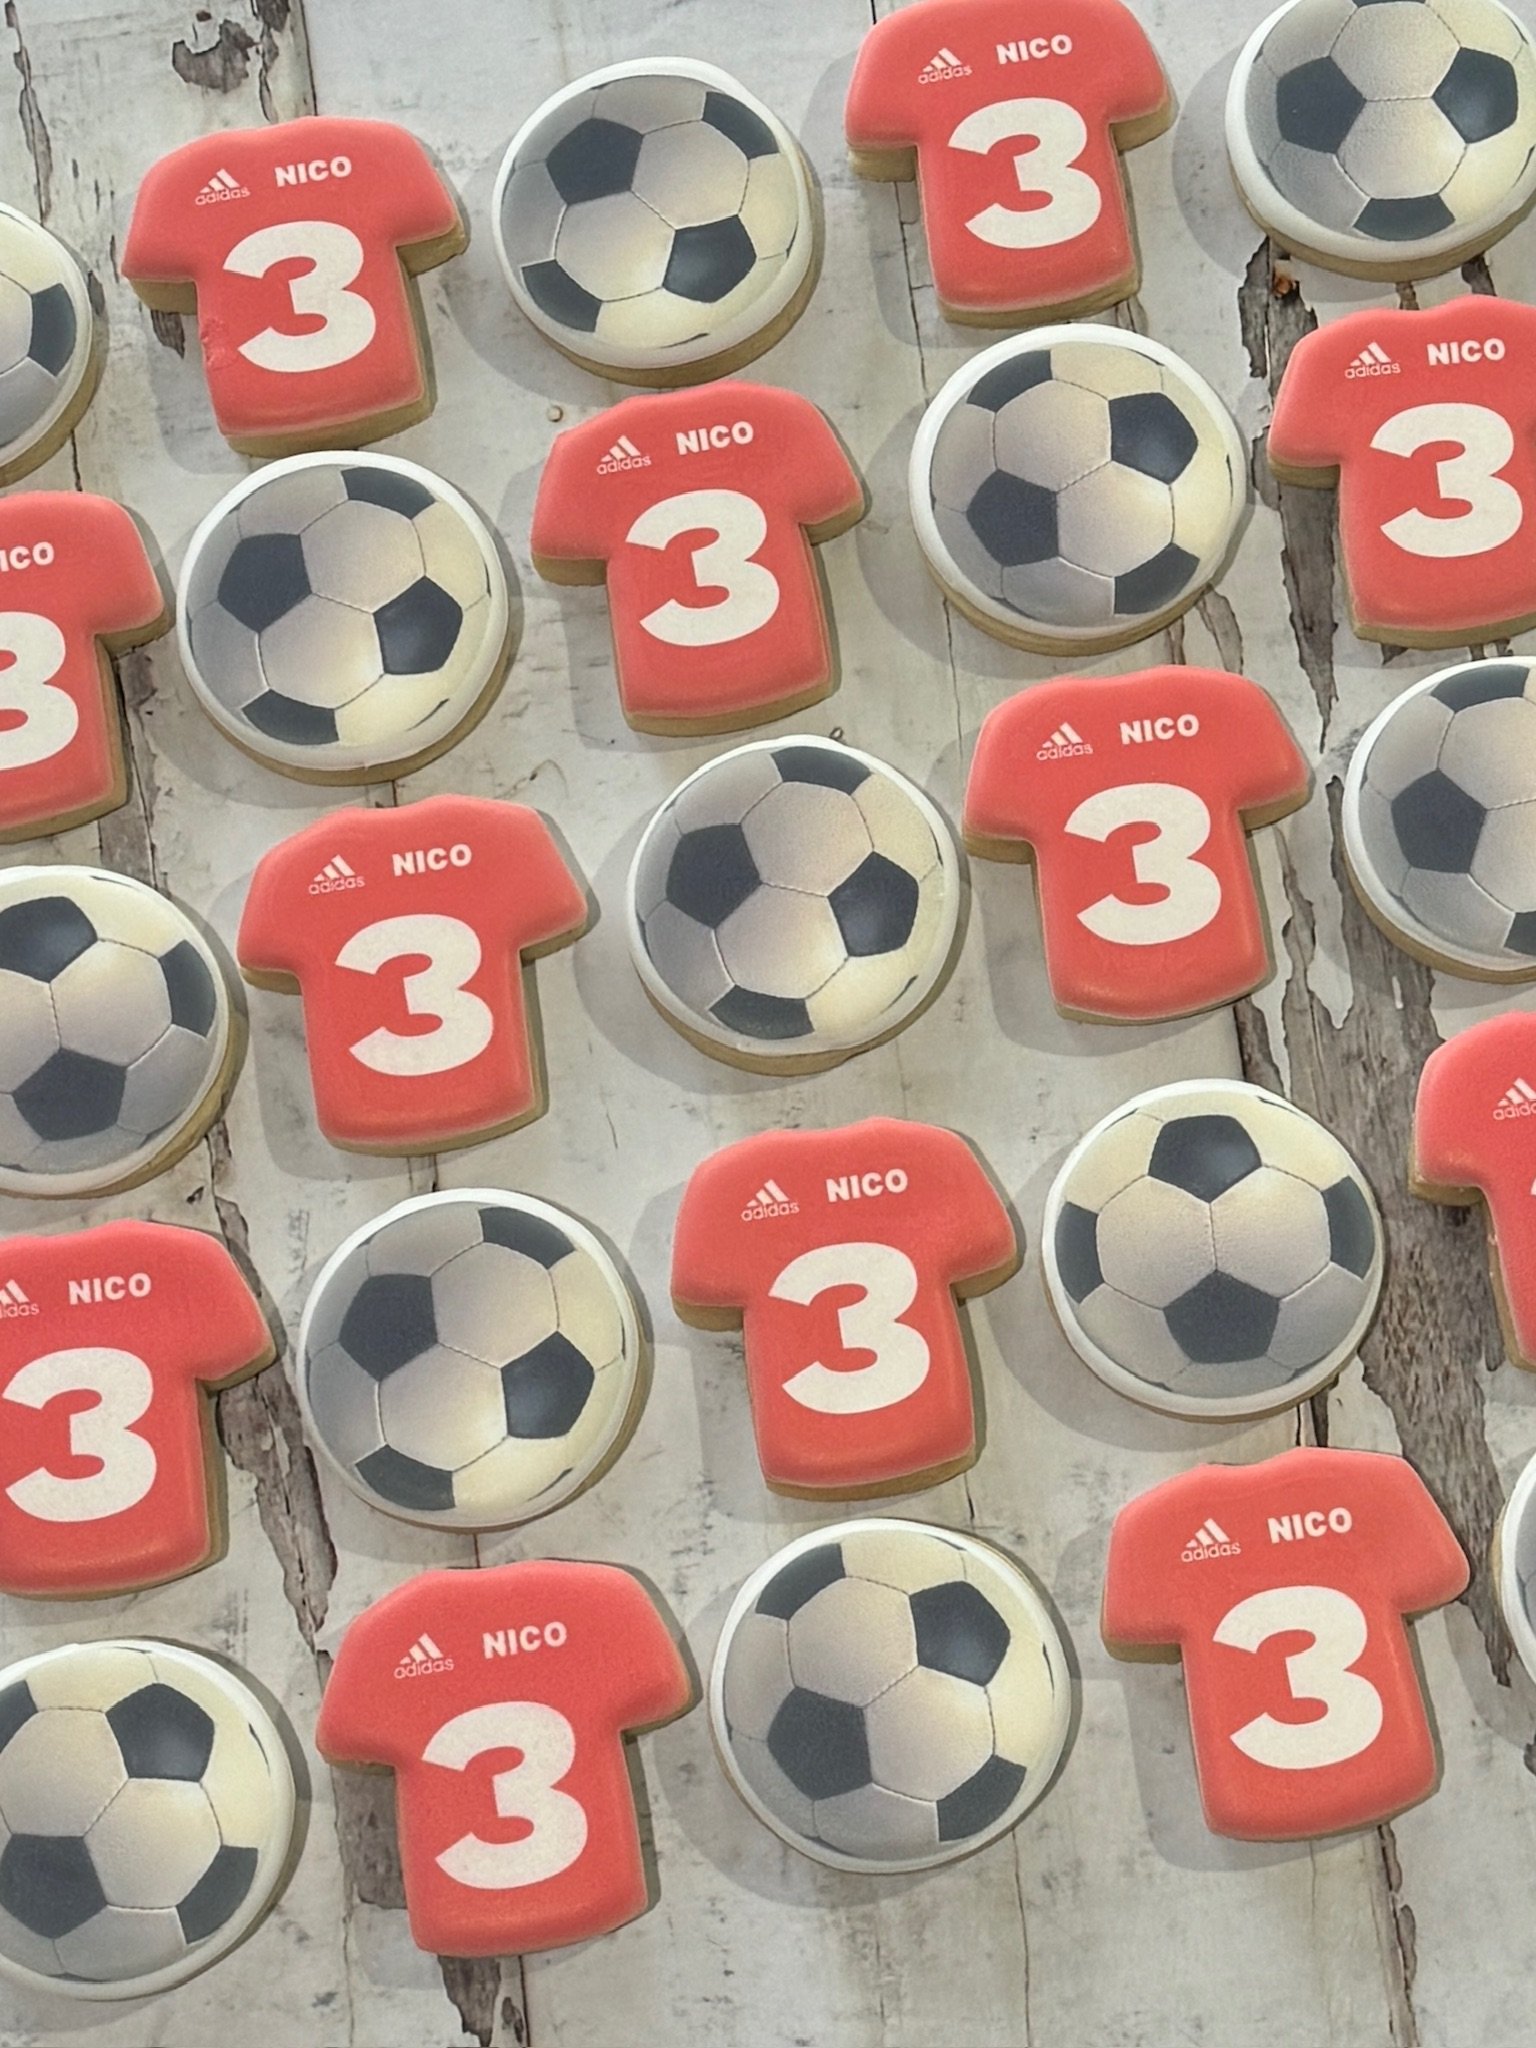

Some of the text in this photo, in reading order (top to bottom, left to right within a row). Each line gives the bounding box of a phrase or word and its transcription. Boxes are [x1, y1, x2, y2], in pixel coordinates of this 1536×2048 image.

[996, 35, 1073, 65] NICO
[917, 64, 973, 85] adidas
[274, 155, 353, 188] NICO
[947, 96, 1103, 250] 3
[194, 186, 250, 207] adidas
[222, 220, 377, 373] 3
[1426, 337, 1506, 366] NICO
[1344, 361, 1401, 379] adidas
[675, 420, 754, 456] NICO
[596, 458, 652, 476] adidas
[1369, 402, 1524, 559] 3
[624, 488, 781, 647] 3
[1119, 713, 1200, 745] NICO
[1036, 744, 1094, 761] adidas
[391, 843, 473, 877] NICO
[1063, 782, 1222, 946] 3
[308, 876, 366, 895] adidas
[334, 913, 495, 1077] 3
[825, 1168, 909, 1203] NICO
[740, 1202, 799, 1223] adidas
[68, 1272, 152, 1305] NICO
[0, 1303, 40, 1319] idas
[767, 1241, 931, 1415] 3
[1, 1346, 158, 1523] 3
[1267, 1506, 1353, 1544] NICO
[1181, 1540, 1242, 1563] adidas
[482, 1621, 568, 1660] NICO
[394, 1657, 454, 1680] adidas
[1212, 1584, 1384, 1771] 3
[420, 1700, 589, 1890] 3
